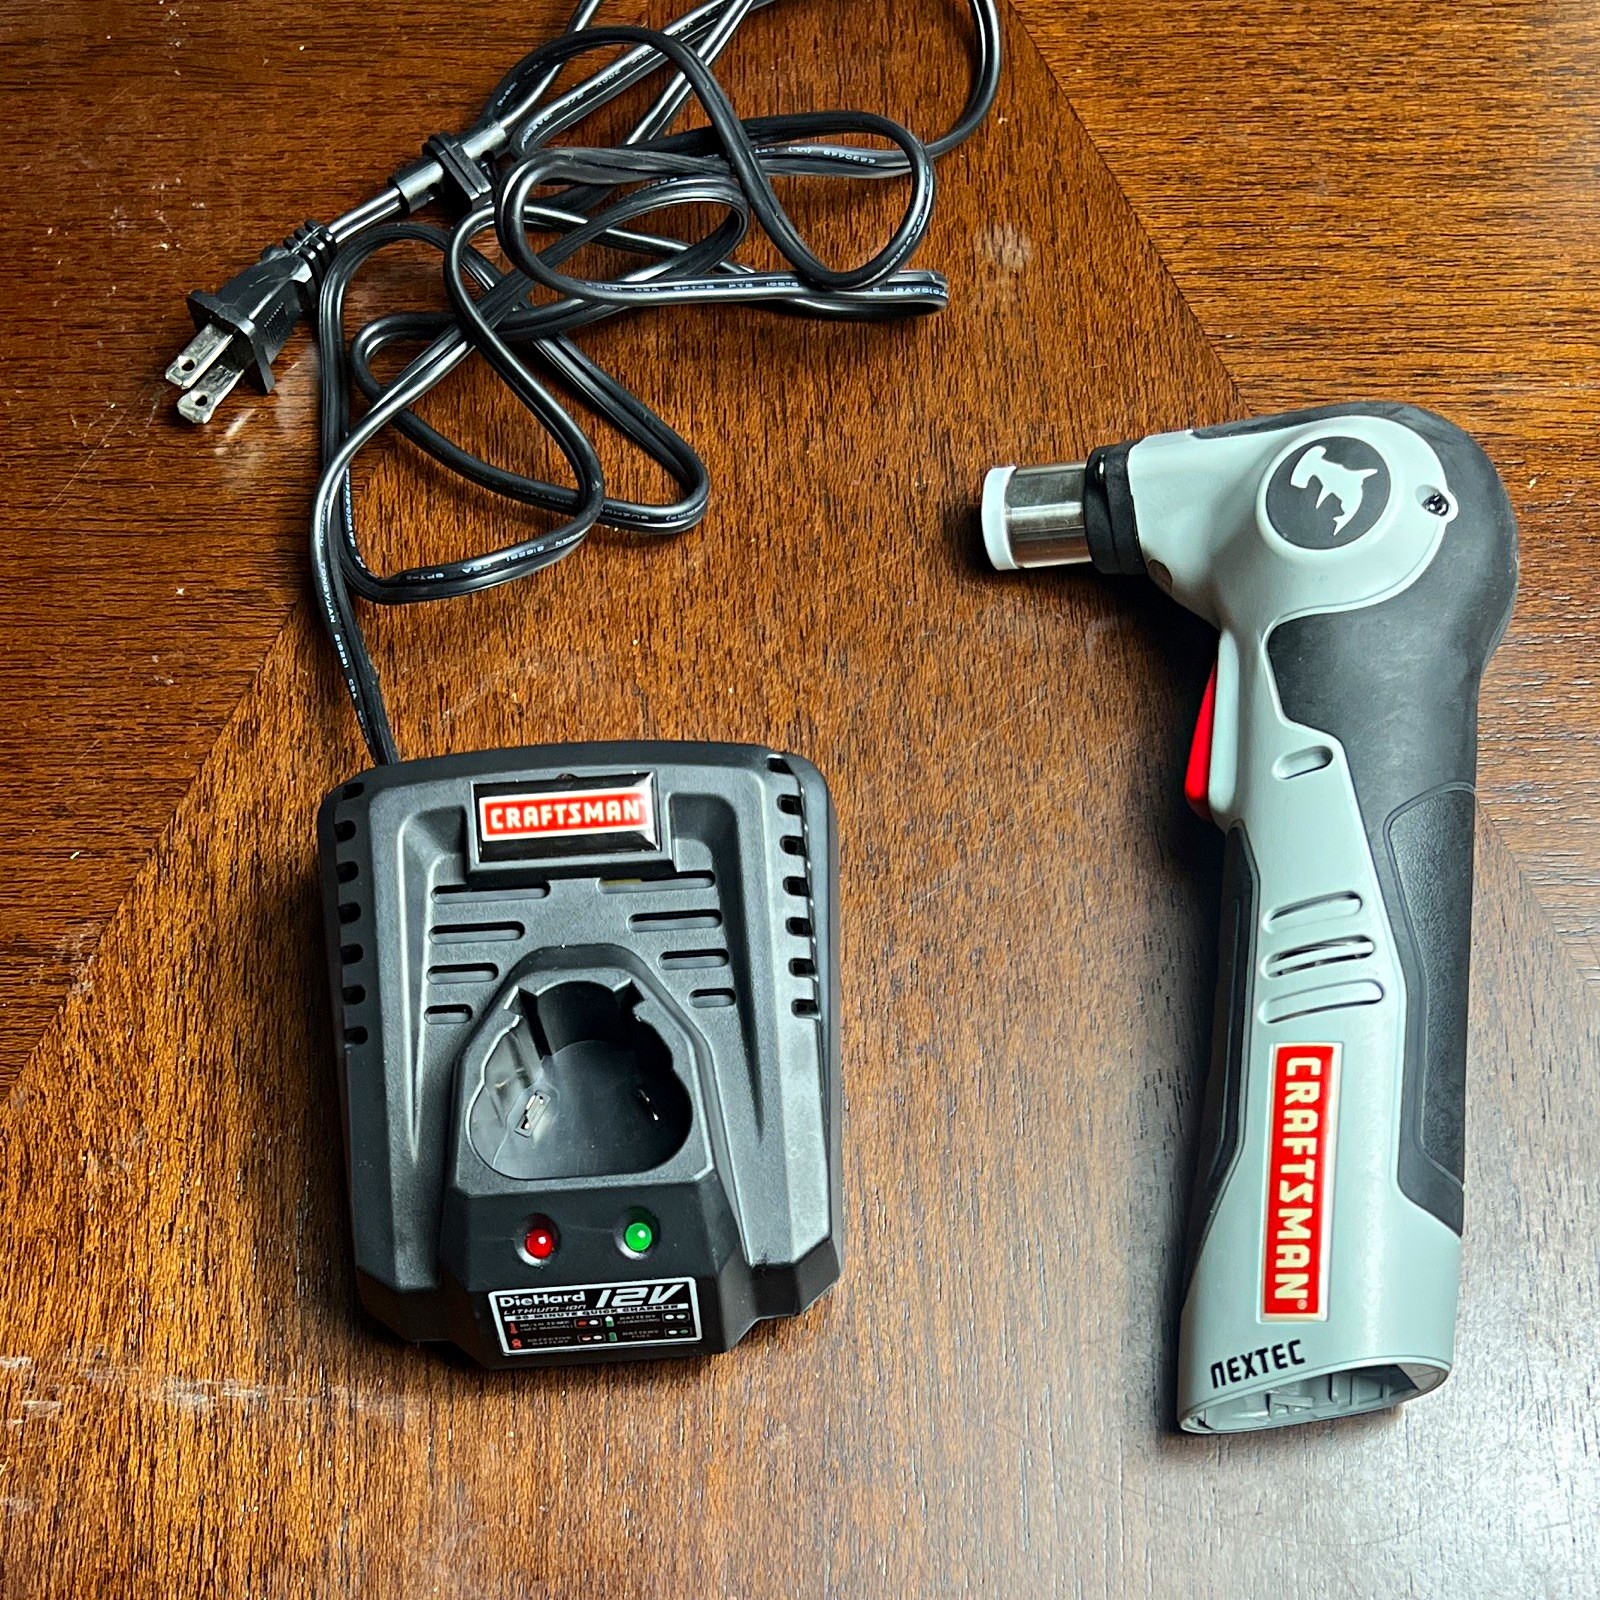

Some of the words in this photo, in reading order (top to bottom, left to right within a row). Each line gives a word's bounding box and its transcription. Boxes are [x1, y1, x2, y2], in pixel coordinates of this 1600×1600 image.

[490, 800, 642, 830] CRAFTSMAN
[499, 1290, 586, 1308] DieHard
[595, 1284, 685, 1309] 12V
[1210, 1338, 1305, 1388] NEXTEC
